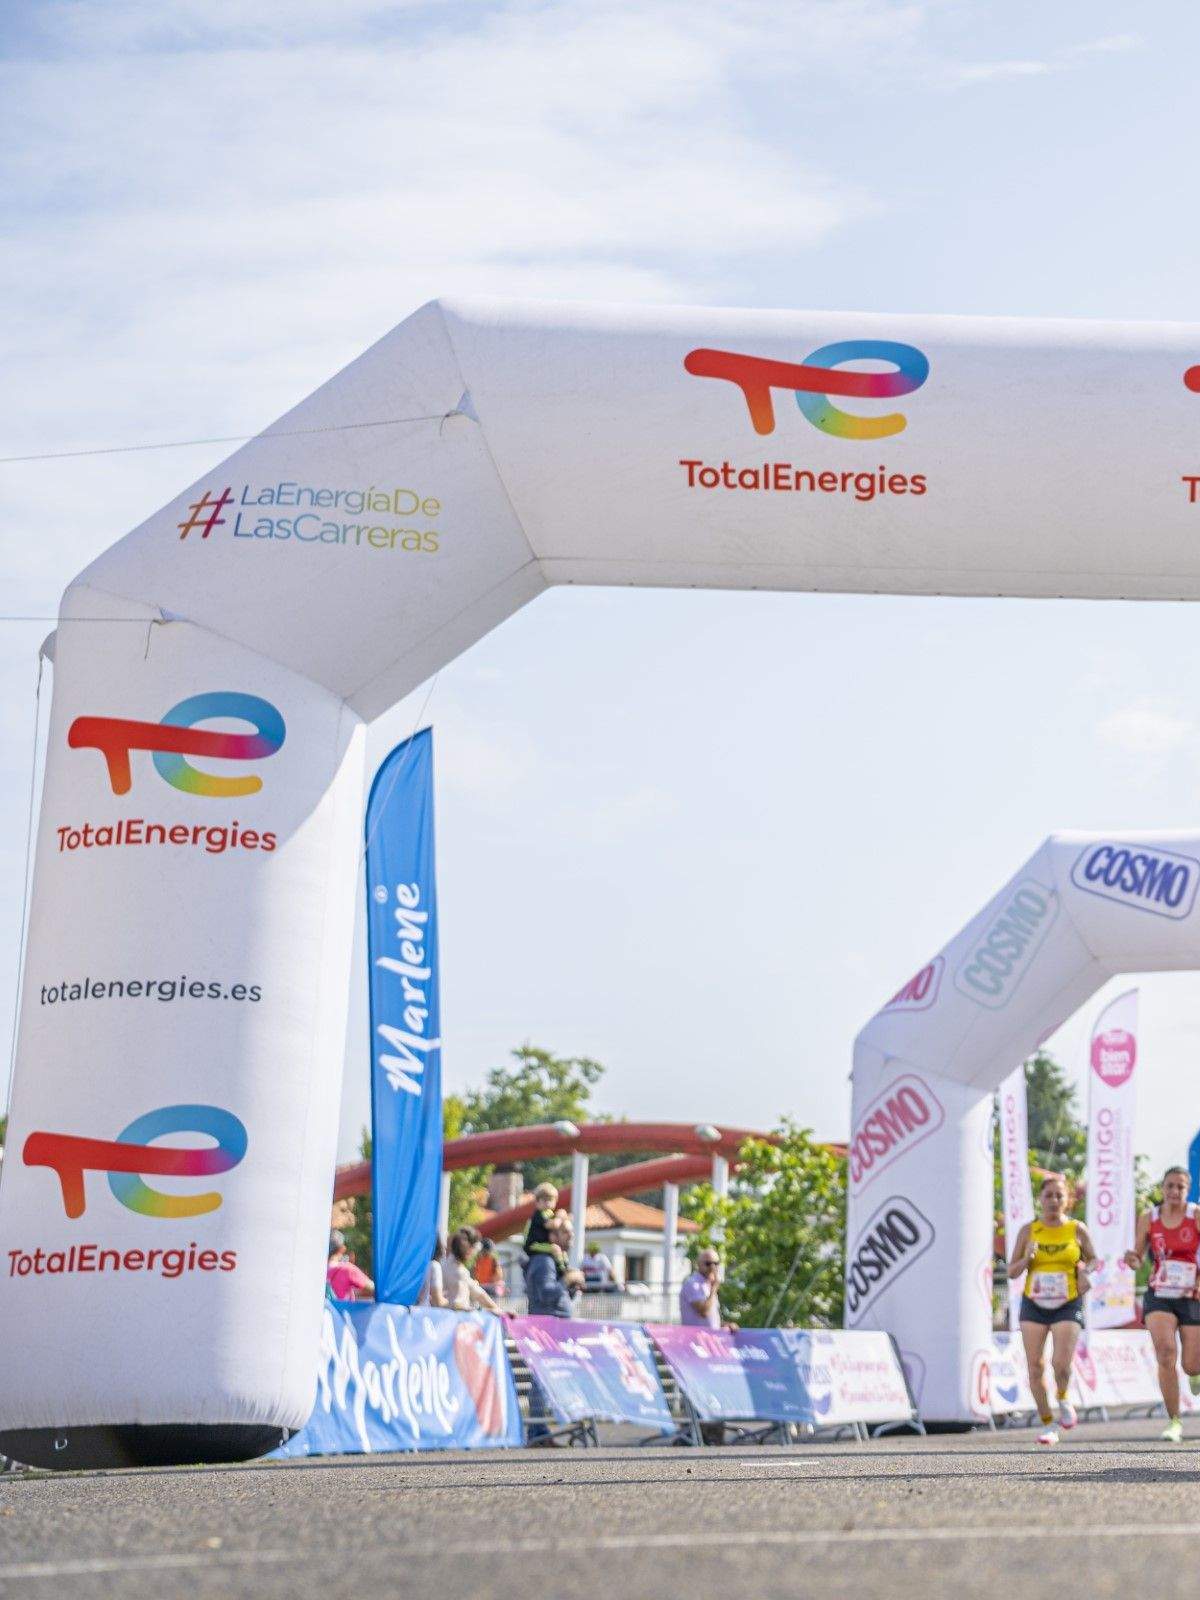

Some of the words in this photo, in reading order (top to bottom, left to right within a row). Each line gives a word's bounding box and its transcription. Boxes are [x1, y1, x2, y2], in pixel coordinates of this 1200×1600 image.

[240, 482, 441, 517] LaEnergíaDe
[680, 460, 928, 501] TotalEnergies
[233, 511, 439, 553] LasCarreras
[57, 819, 277, 854] TotalEnergies
[1084, 845, 1190, 909] COSMO
[963, 887, 1048, 997] COSMO
[40, 975, 262, 1006] totalenergies.es
[377, 882, 441, 1096] Marlene
[1096, 1108, 1114, 1227] CONTIGO
[8, 1243, 237, 1279] TotalEnergies
[318, 1308, 459, 1453] Marlene
